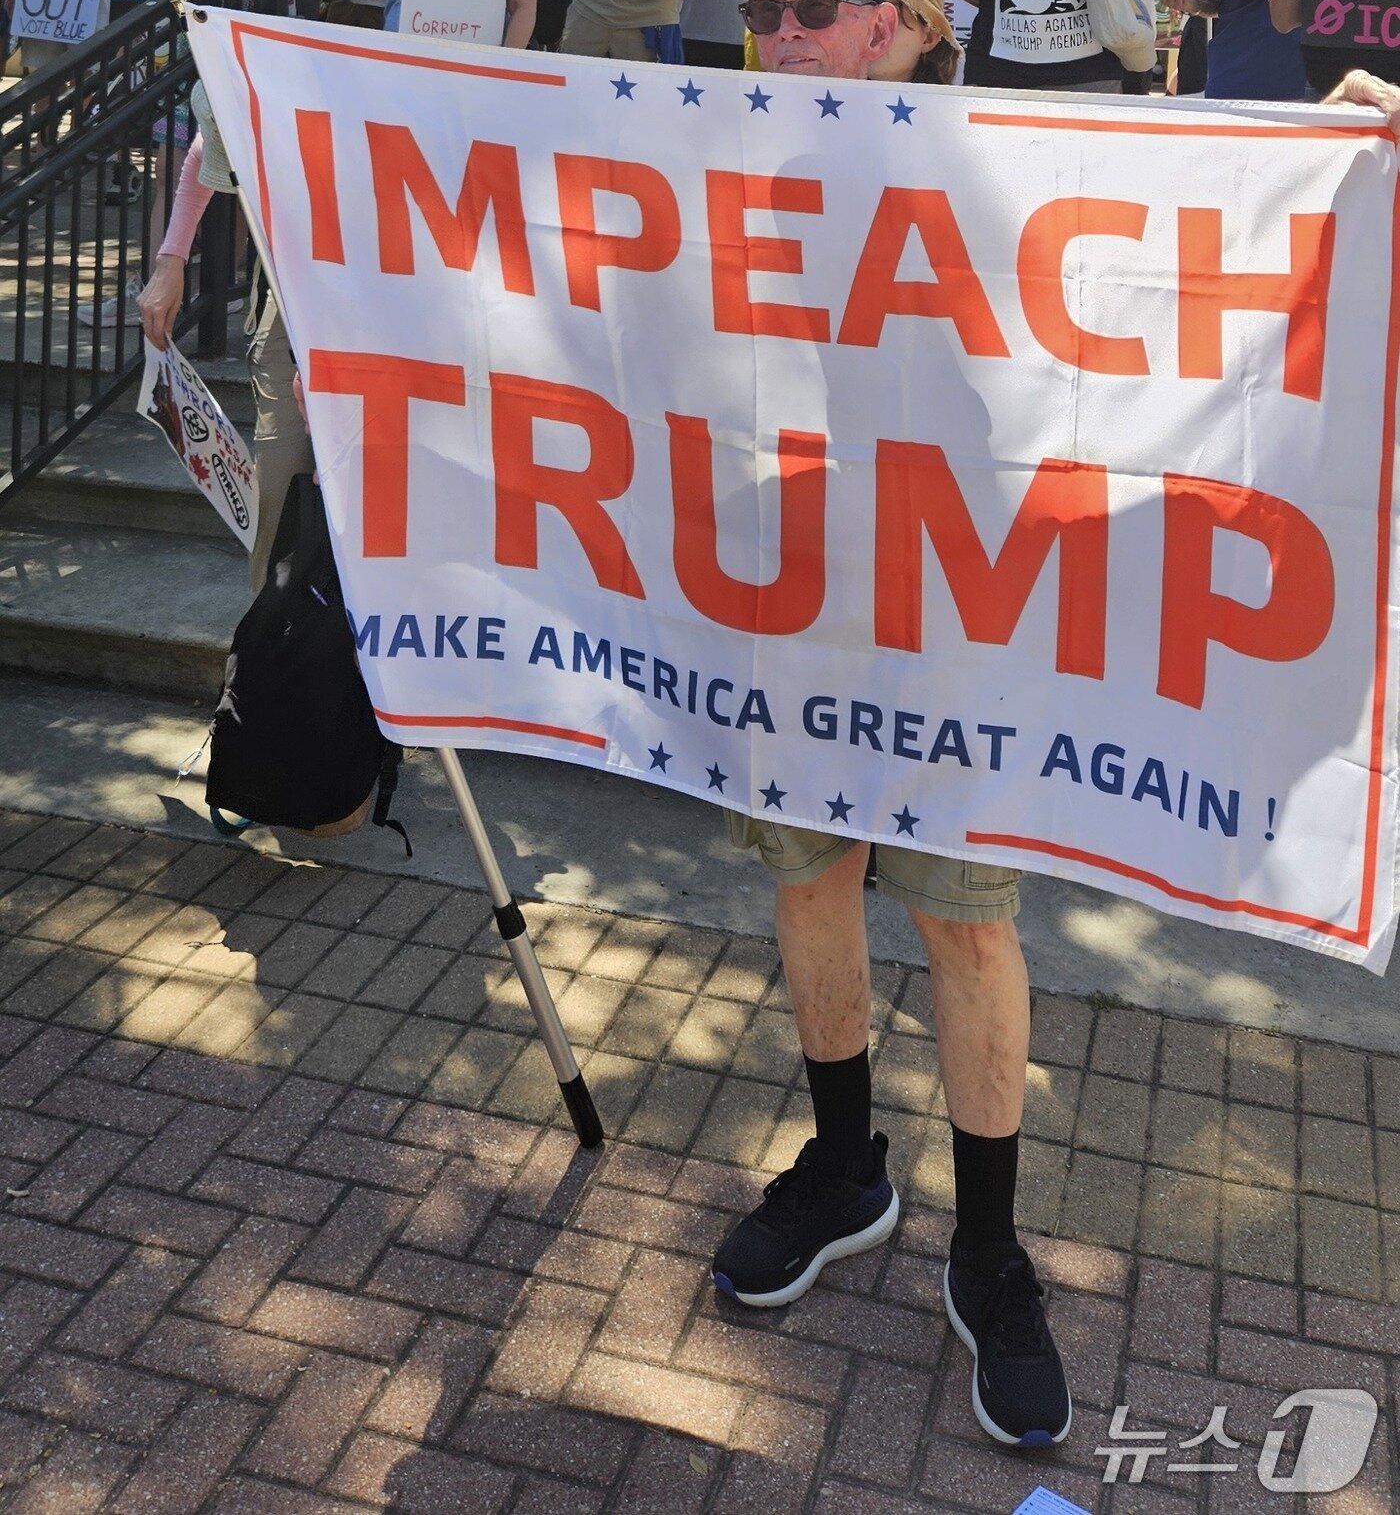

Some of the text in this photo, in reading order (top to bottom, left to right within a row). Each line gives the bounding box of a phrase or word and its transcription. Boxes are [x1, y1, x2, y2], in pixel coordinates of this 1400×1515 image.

[20, 17, 88, 39] VOTE BLUE
[1000, 13, 1090, 34] DALLAS AGAINST
[1012, 35, 1043, 50] TRUMP
[1050, 31, 1094, 50] AGENDA!
[295, 108, 1336, 402] IMPEACH
[308, 348, 1336, 710] TRUMP
[346, 608, 506, 661] MAKE
[528, 626, 777, 734] AMERICA
[802, 695, 1017, 772] GREAT
[1039, 732, 1240, 838] AGAIN
